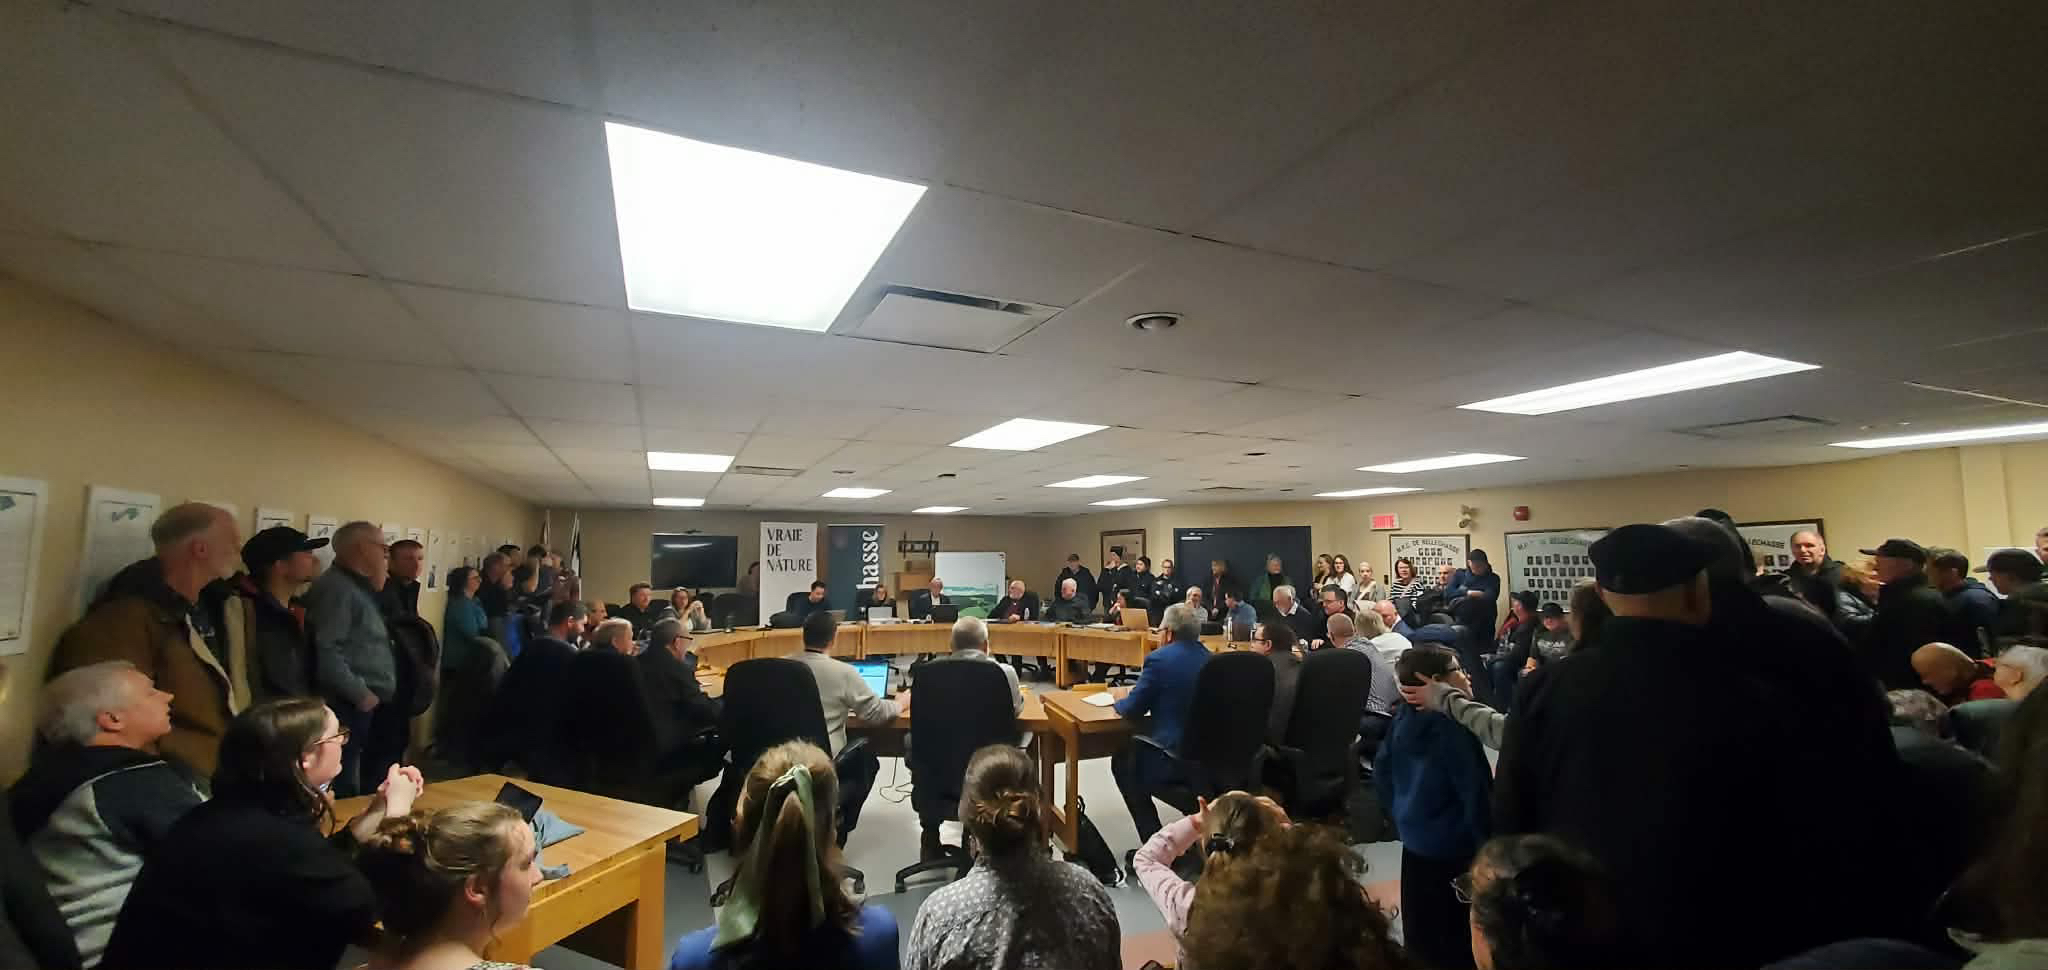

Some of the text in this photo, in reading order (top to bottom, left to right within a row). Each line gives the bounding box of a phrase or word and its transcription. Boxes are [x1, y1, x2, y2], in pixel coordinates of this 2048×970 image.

[767, 528, 803, 541] VRAIE
[767, 544, 781, 556] DE
[767, 559, 813, 571] NATURE
